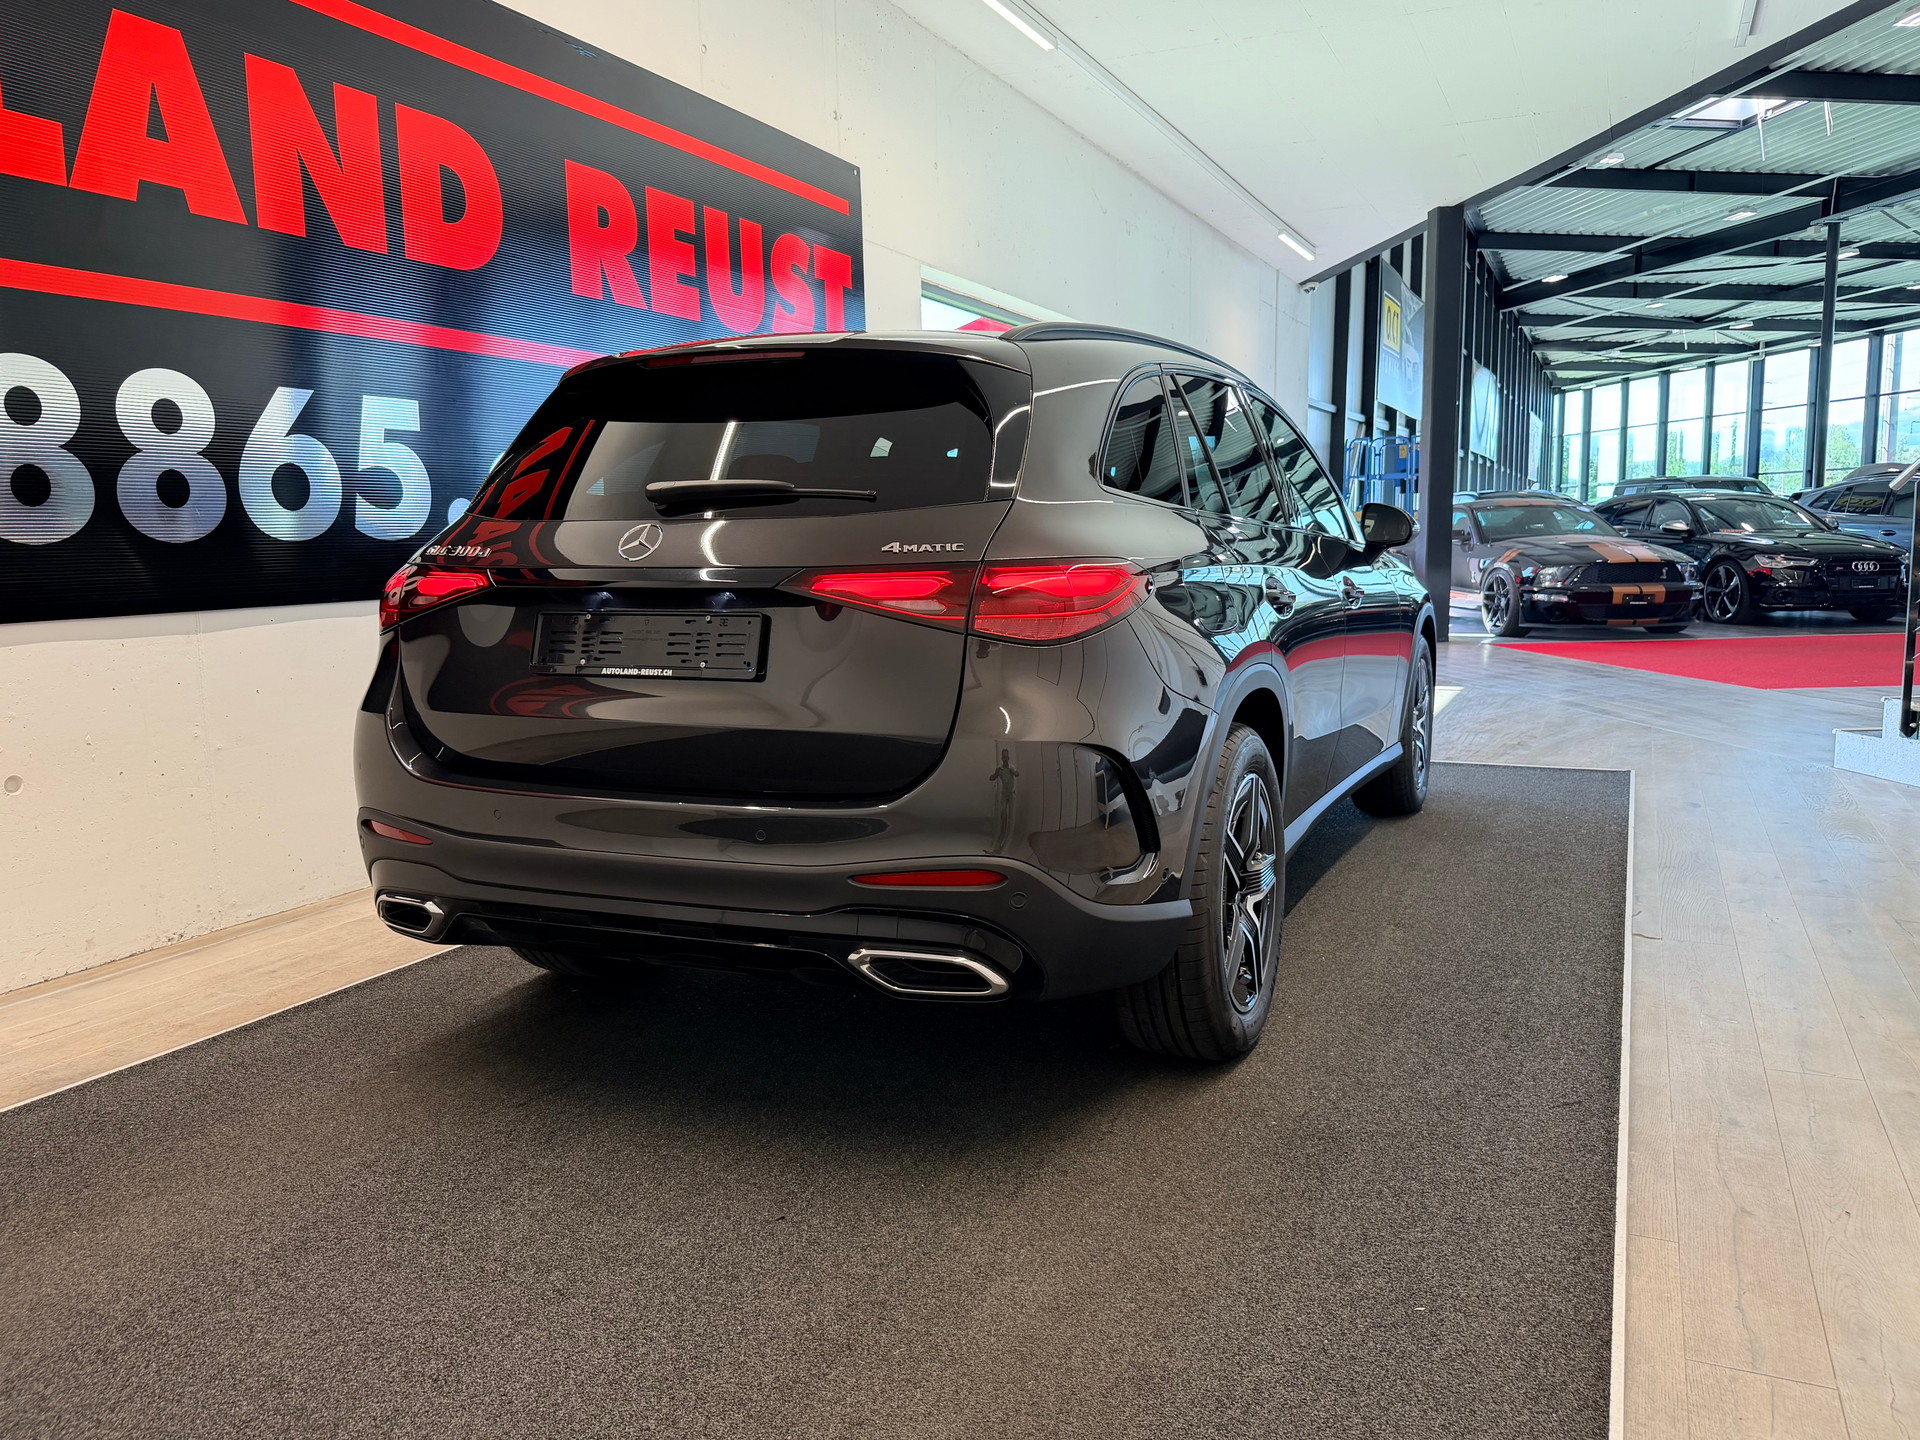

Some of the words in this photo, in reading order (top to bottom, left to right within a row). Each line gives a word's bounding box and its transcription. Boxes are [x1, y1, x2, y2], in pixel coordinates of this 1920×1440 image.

[565, 159, 852, 334] REUST
[0, 353, 505, 544] 8865.
[881, 541, 965, 553] 4MATIC
[601, 667, 673, 677] AUTOLAND-REUST.CH
